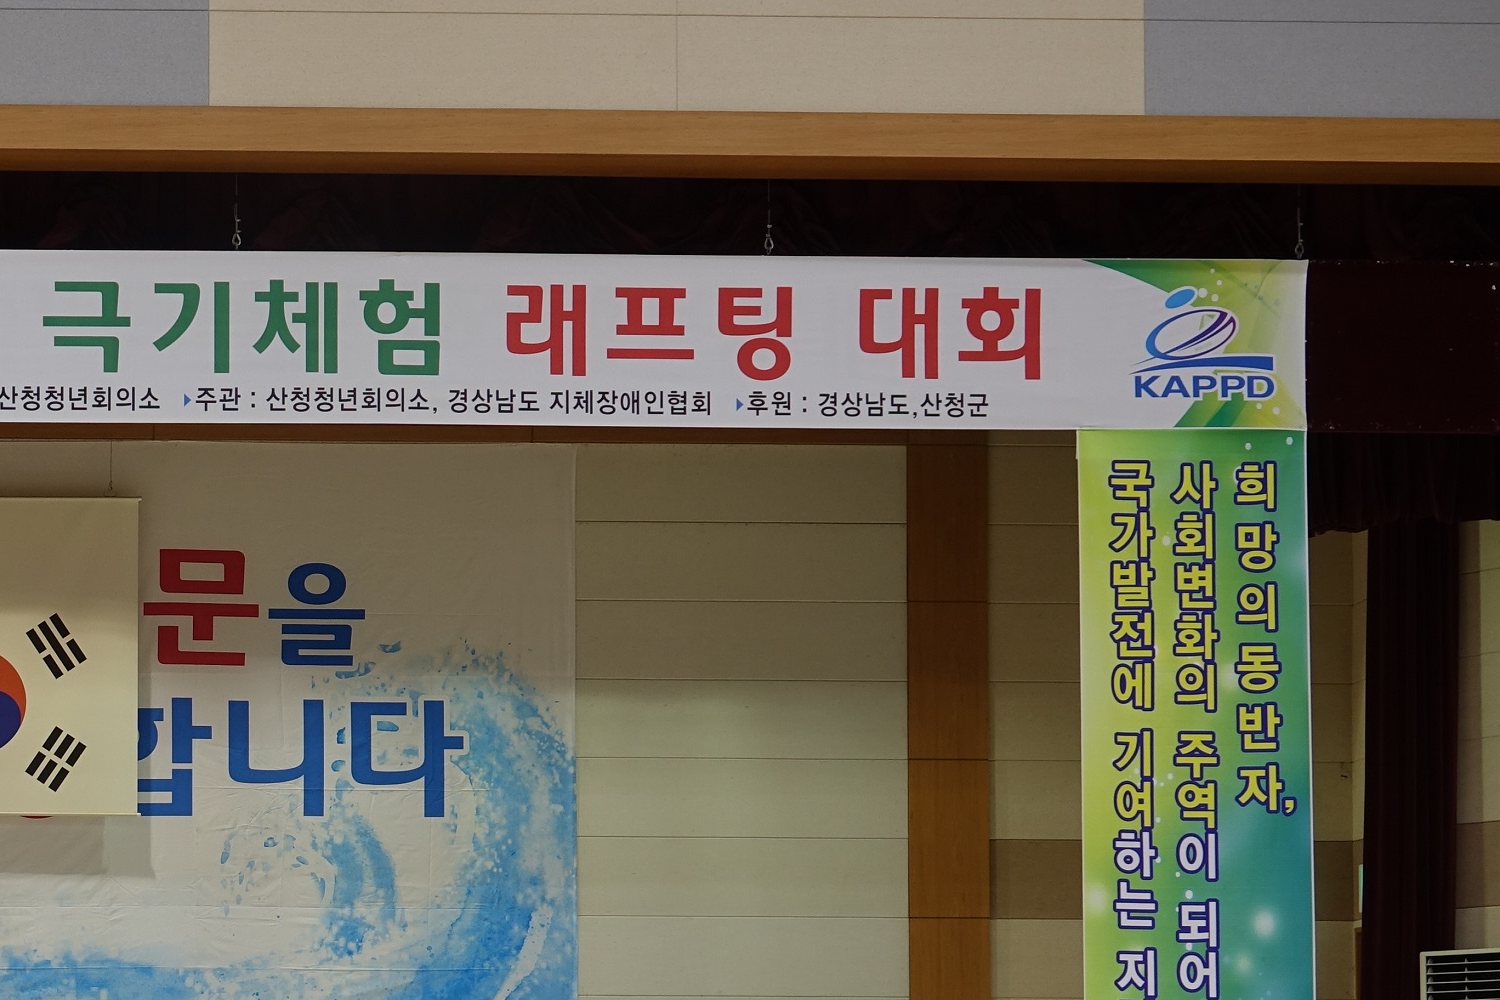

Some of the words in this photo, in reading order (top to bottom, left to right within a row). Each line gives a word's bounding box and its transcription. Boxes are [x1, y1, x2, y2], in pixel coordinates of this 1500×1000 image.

[42, 279, 442, 377] 극기체험
[505, 282, 794, 381] 래프팅
[859, 286, 1042, 381] 대회
[195, 386, 242, 412] 주관
[266, 386, 438, 414] 산청청년회의소,
[448, 388, 541, 414] 경상남도
[549, 388, 713, 415] 지체장애인협회
[746, 390, 792, 417] 후원
[1133, 371, 1276, 402] KAPPD
[1108, 459, 1156, 712] 국가발전에
[1171, 459, 1220, 713] 사회변화의
[1113, 728, 1159, 930] 기여하는
[1173, 730, 1220, 880] 주역이
[1176, 898, 1220, 1000] 되어
